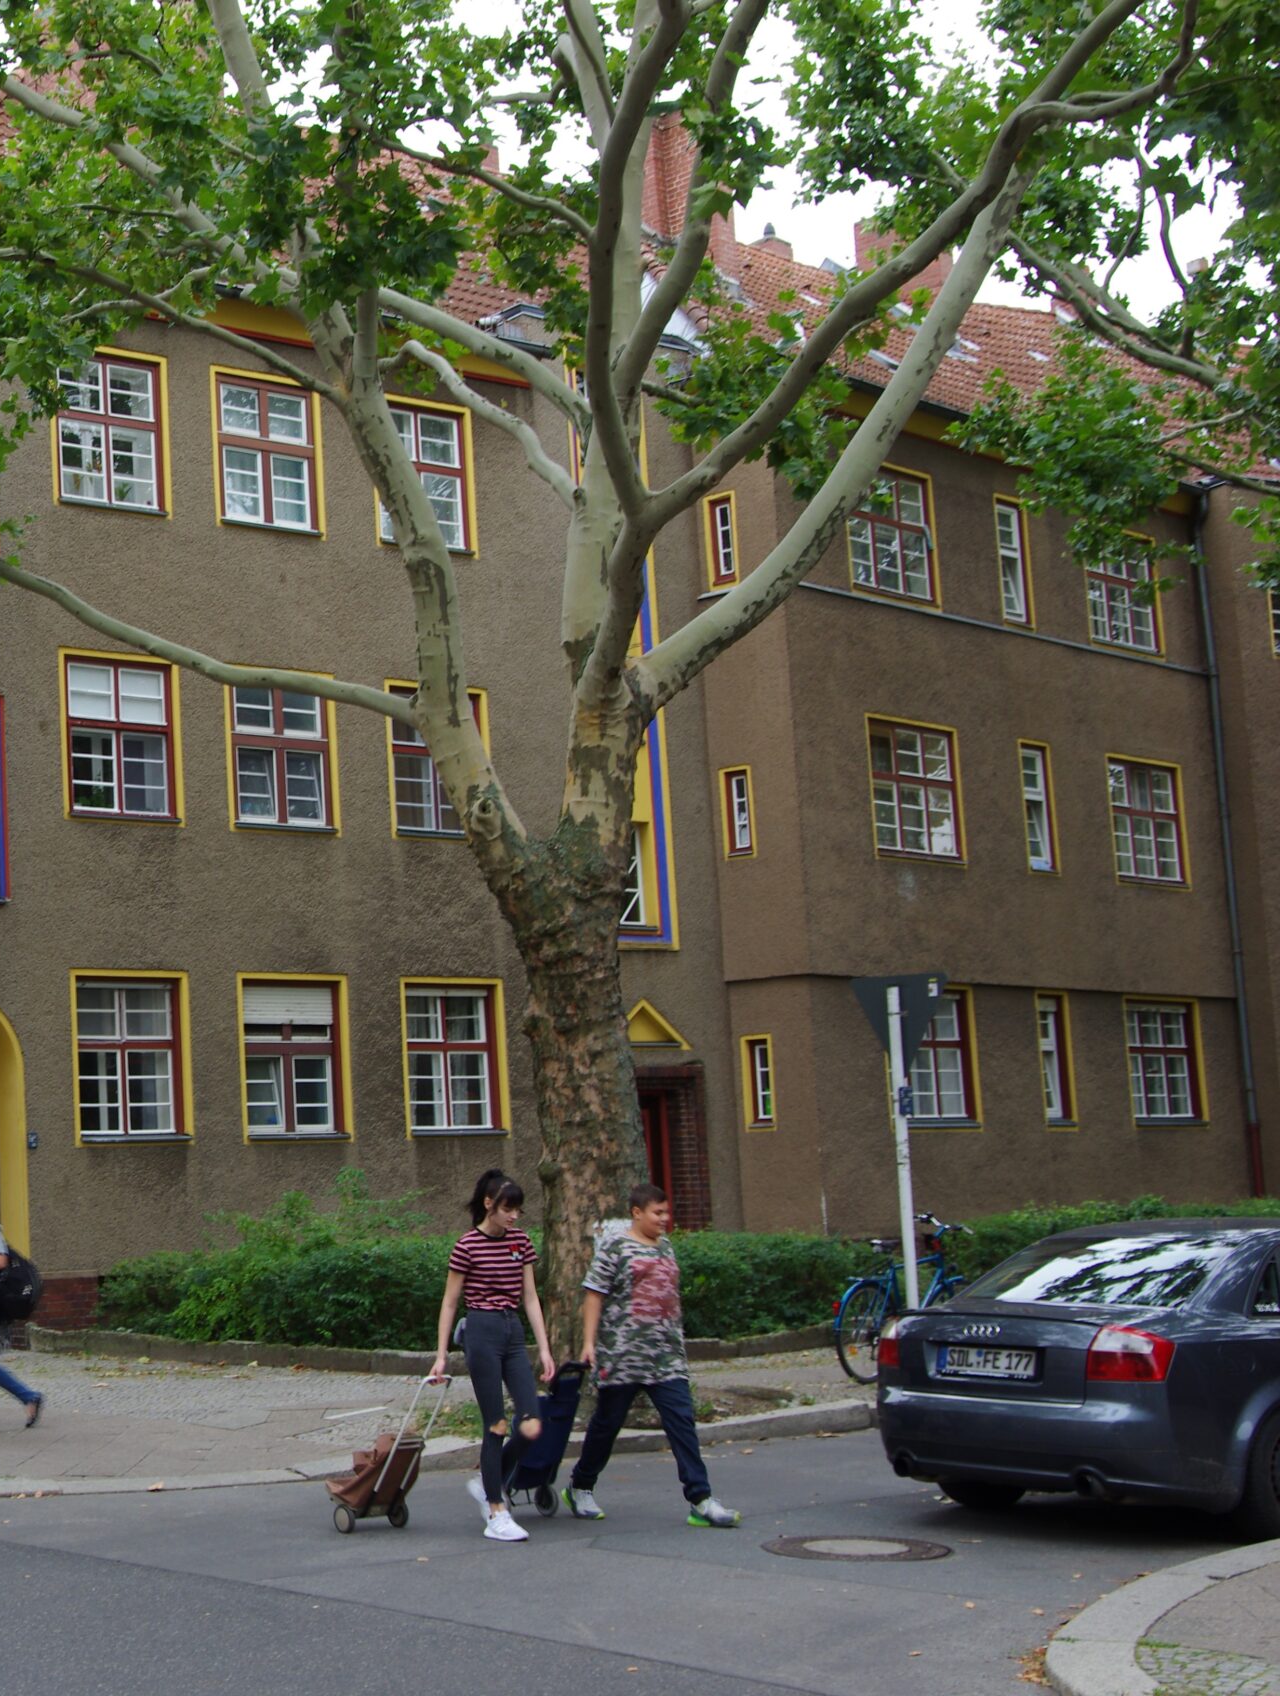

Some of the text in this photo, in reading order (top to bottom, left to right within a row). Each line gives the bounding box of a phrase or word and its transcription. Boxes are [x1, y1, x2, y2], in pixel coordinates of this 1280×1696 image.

[947, 1348, 1034, 1372] SDL FE 177
